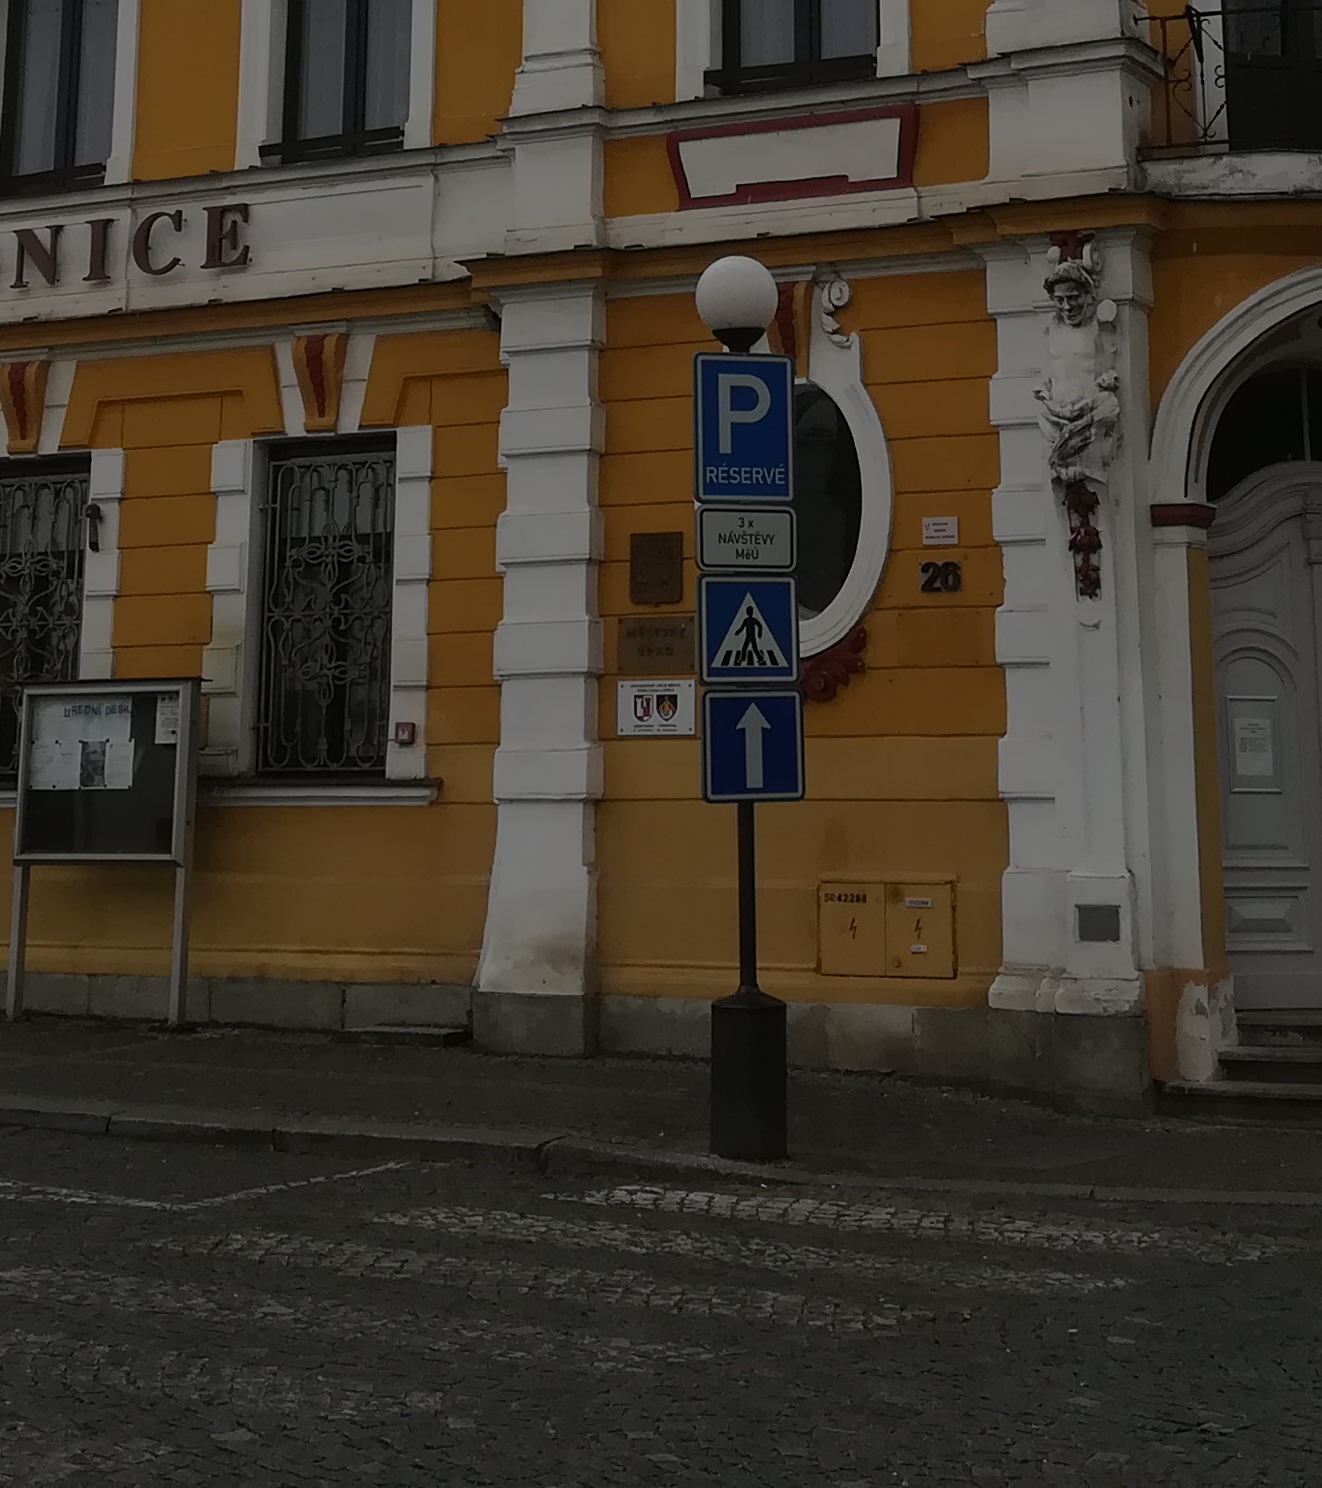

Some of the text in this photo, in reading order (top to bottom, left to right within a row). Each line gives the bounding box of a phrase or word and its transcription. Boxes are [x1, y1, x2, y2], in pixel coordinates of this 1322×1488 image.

[717, 373, 772, 454] P
[706, 463, 786, 485] RÉSERVÉ
[738, 517, 755, 528] 3 x
[718, 530, 775, 545] NÁVŠTĚVY
[921, 561, 961, 592] 26
